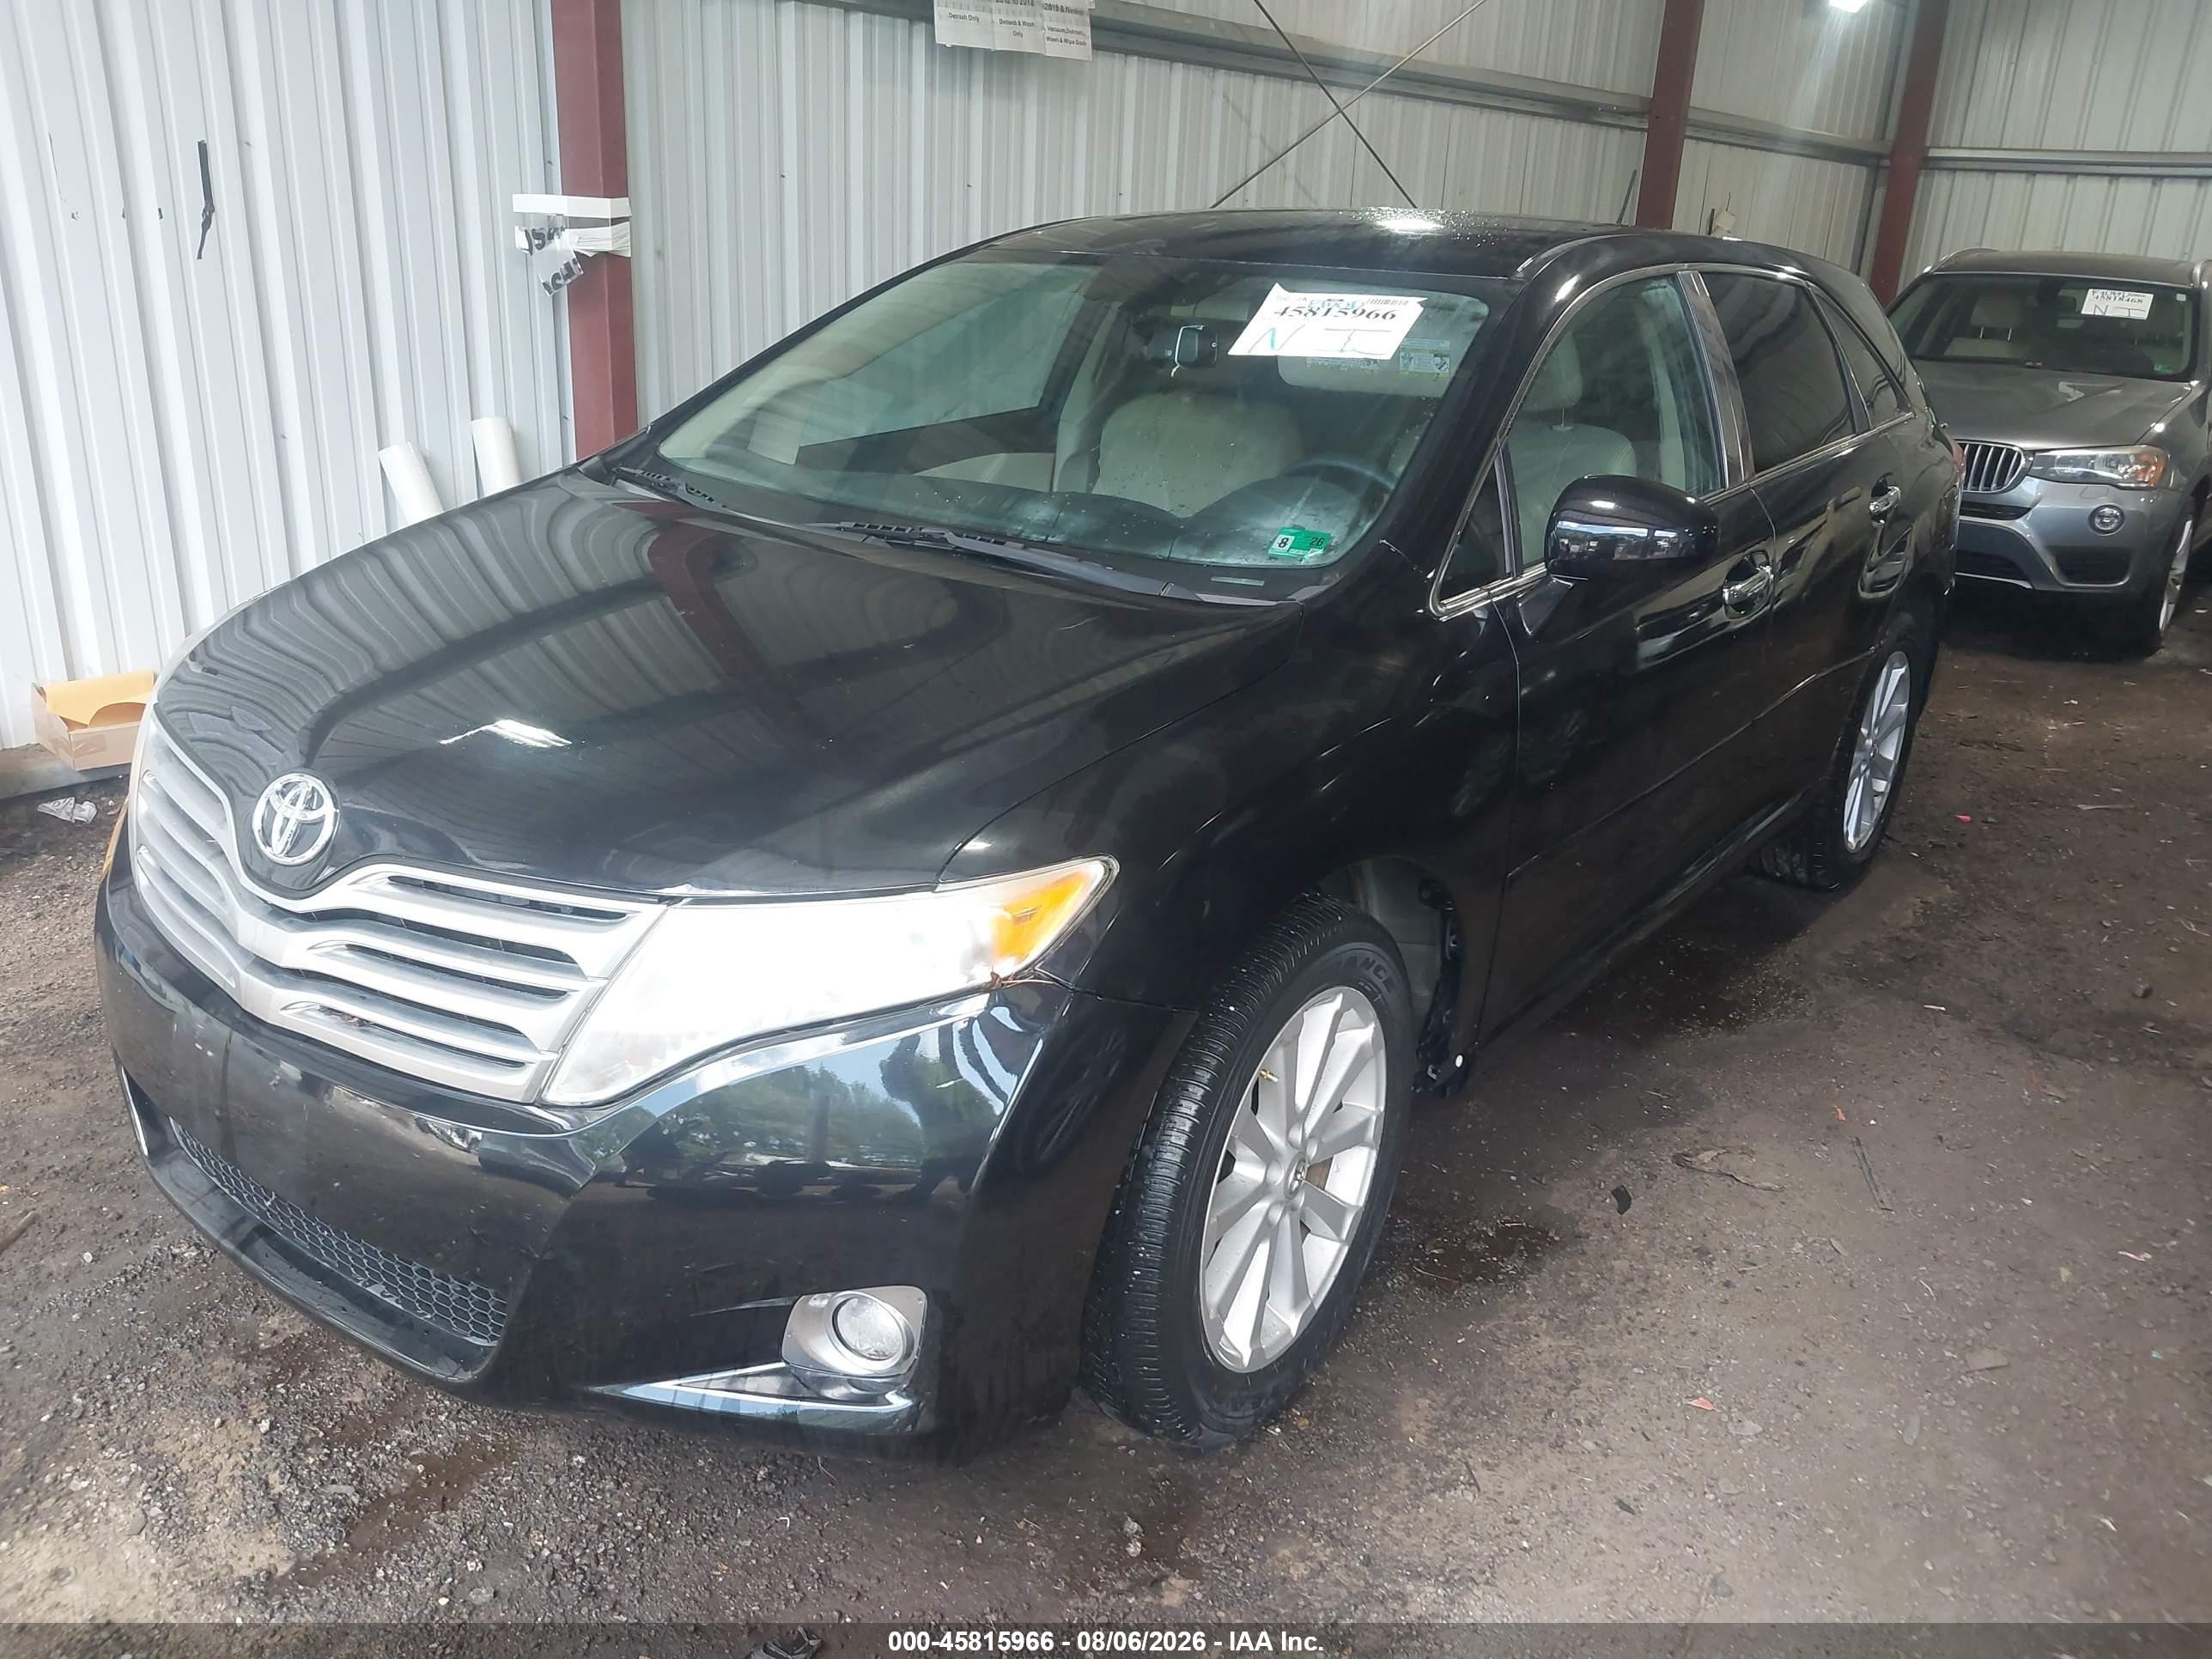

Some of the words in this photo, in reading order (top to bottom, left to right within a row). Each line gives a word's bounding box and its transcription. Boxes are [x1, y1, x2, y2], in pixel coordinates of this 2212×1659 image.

[1044, 3, 1060, 12] 2019
[948, 12, 968, 21] Detrash
[968, 15, 980, 23] Only
[1012, 30, 1024, 39] Only
[1274, 305, 1397, 321] 45815966
[1278, 537, 1289, 548] 8
[1309, 537, 1325, 547] 26
